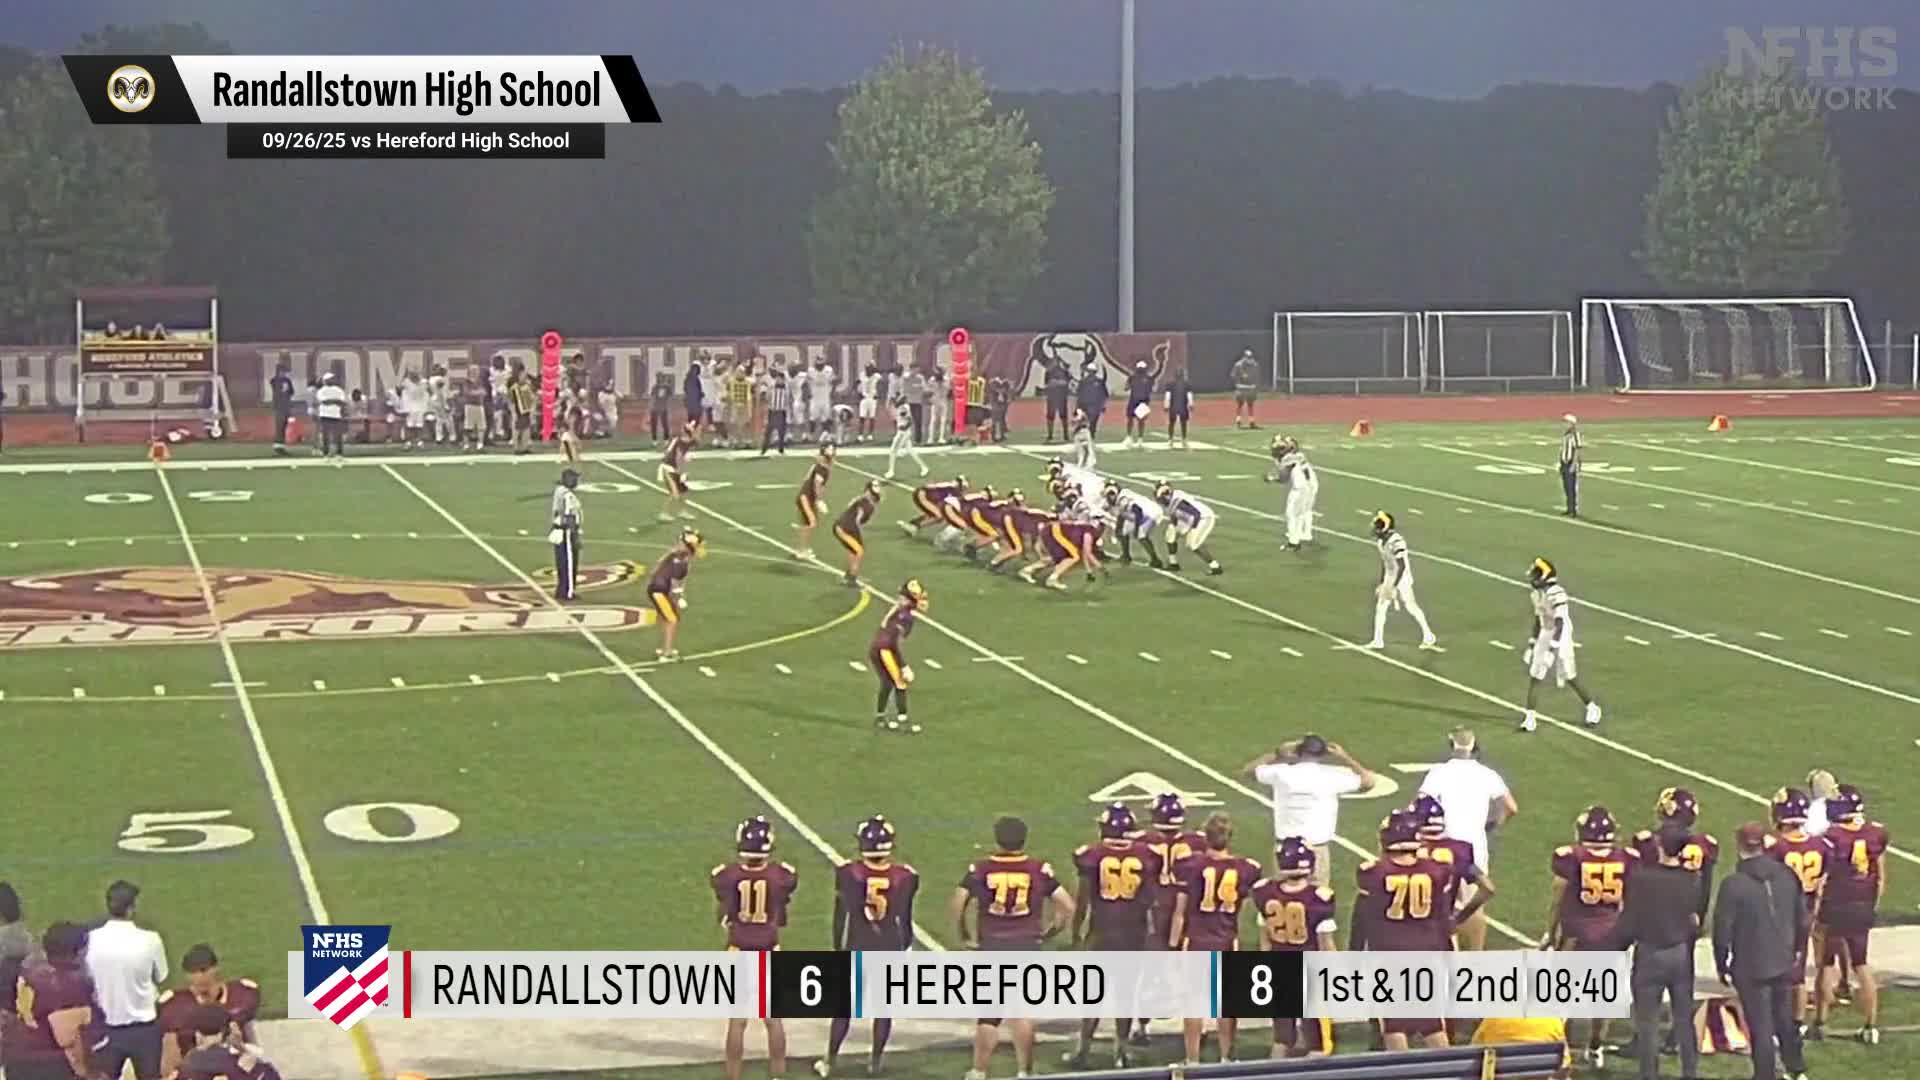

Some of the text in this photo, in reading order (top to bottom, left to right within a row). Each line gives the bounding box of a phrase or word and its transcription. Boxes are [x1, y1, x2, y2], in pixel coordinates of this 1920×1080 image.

[863, 877, 891, 922] 5
[986, 871, 1031, 916] 77
[1099, 856, 1143, 901] 66
[1201, 866, 1239, 913] 14
[1385, 873, 1432, 920] 70
[1580, 862, 1626, 904] 55
[737, 879, 768, 924] 11
